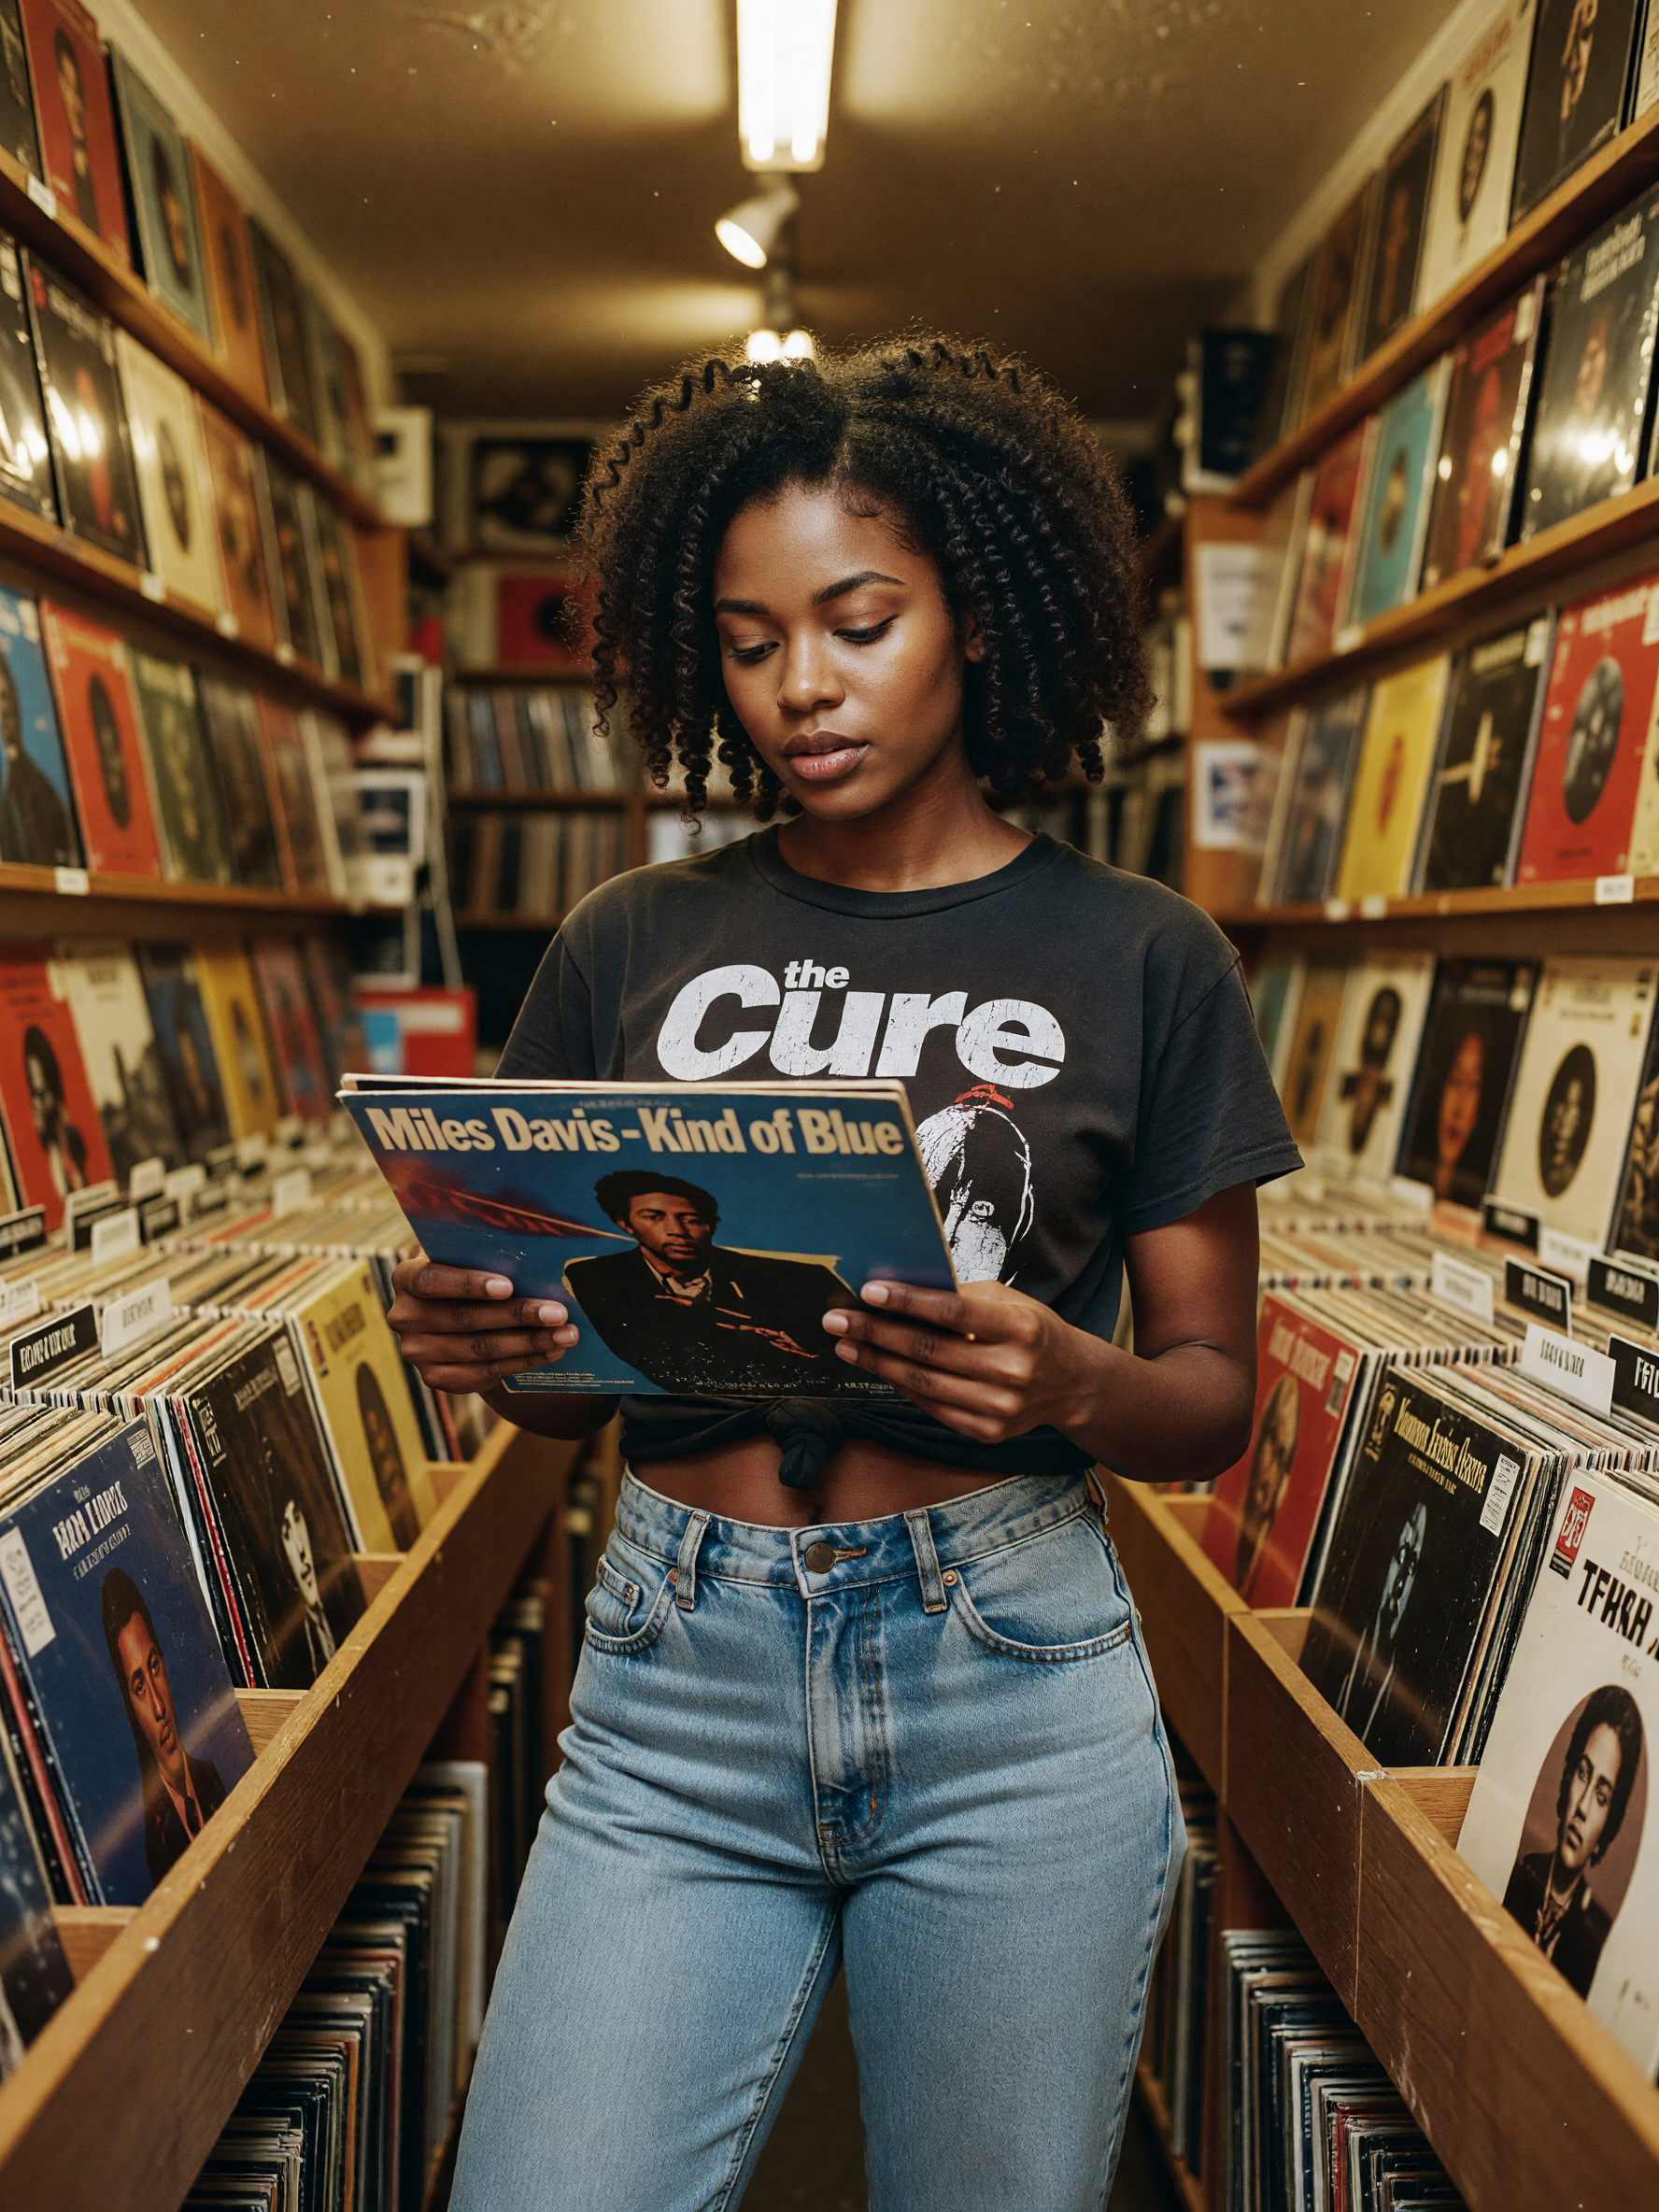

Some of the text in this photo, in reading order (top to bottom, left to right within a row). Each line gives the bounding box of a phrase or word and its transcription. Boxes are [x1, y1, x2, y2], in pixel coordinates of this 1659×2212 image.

[784, 958, 850, 988] the
[657, 964, 1066, 1089] Cure
[364, 1107, 496, 1152] Miles
[748, 1108, 797, 1155] of
[796, 1108, 905, 1156] Blue
